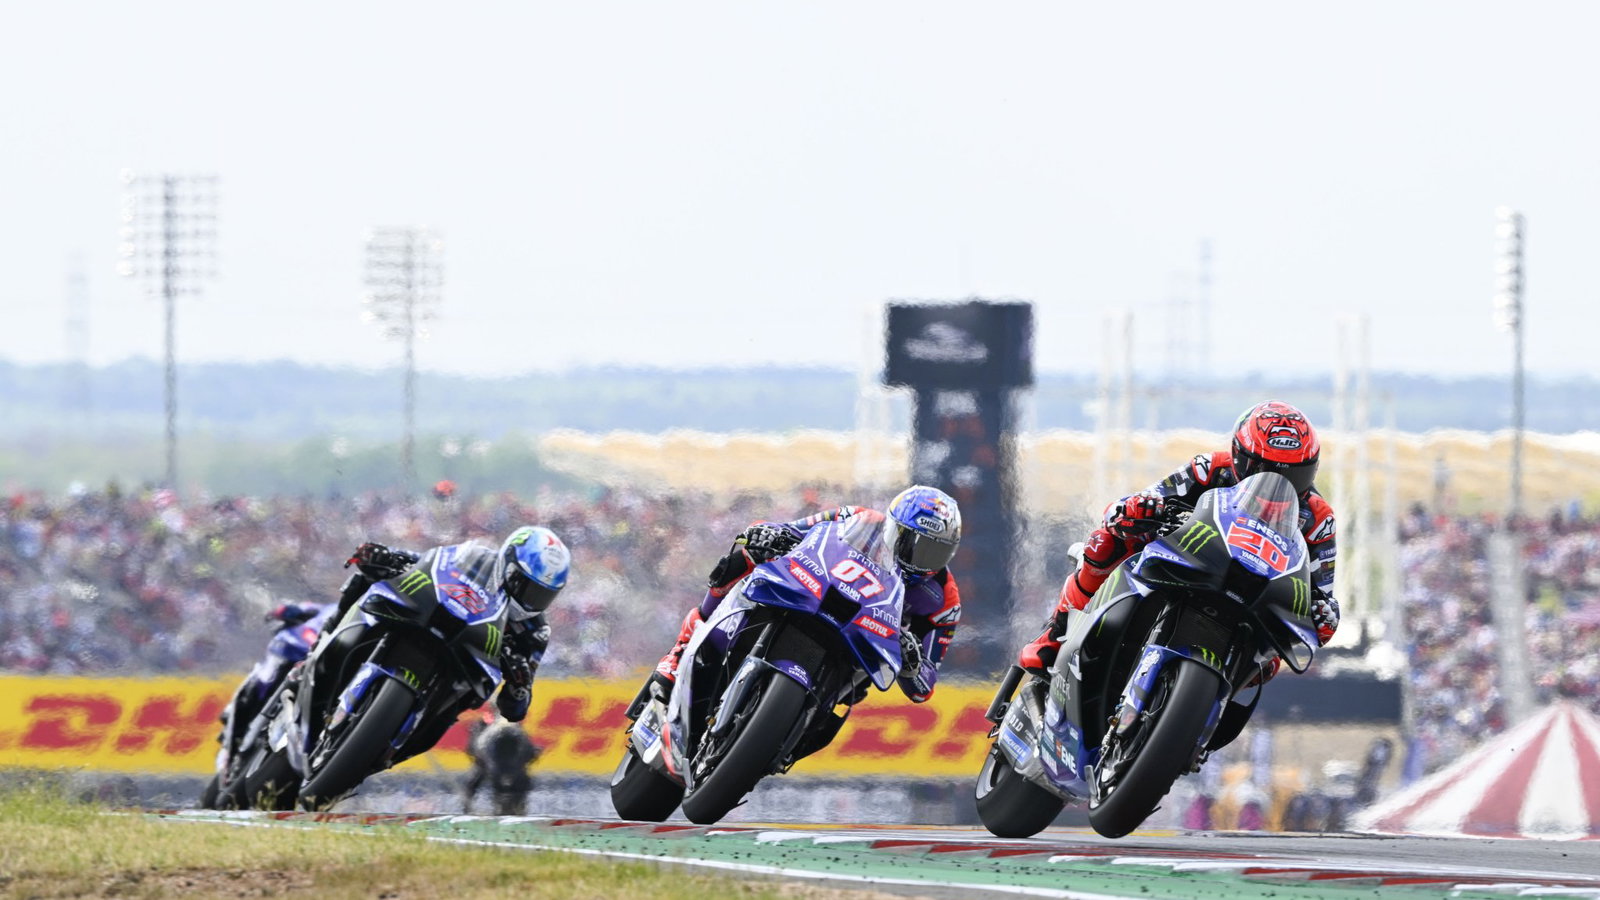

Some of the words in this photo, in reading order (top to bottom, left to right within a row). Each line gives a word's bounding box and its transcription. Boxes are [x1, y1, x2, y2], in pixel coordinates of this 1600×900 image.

[1270, 438, 1298, 448] HJC
[919, 517, 940, 531] SHOEI
[1245, 518, 1288, 551] ENEOS
[1227, 522, 1290, 572] 20
[791, 550, 824, 576] prima
[848, 550, 881, 576] prima
[791, 566, 821, 592] MOTUL
[830, 559, 885, 598] 07
[839, 582, 861, 601] FIAMM
[860, 616, 888, 636] MOTUL
[872, 607, 899, 628] prima
[20, 694, 222, 756] DH
[836, 704, 997, 762] DH
[1061, 748, 1078, 775] ENE
